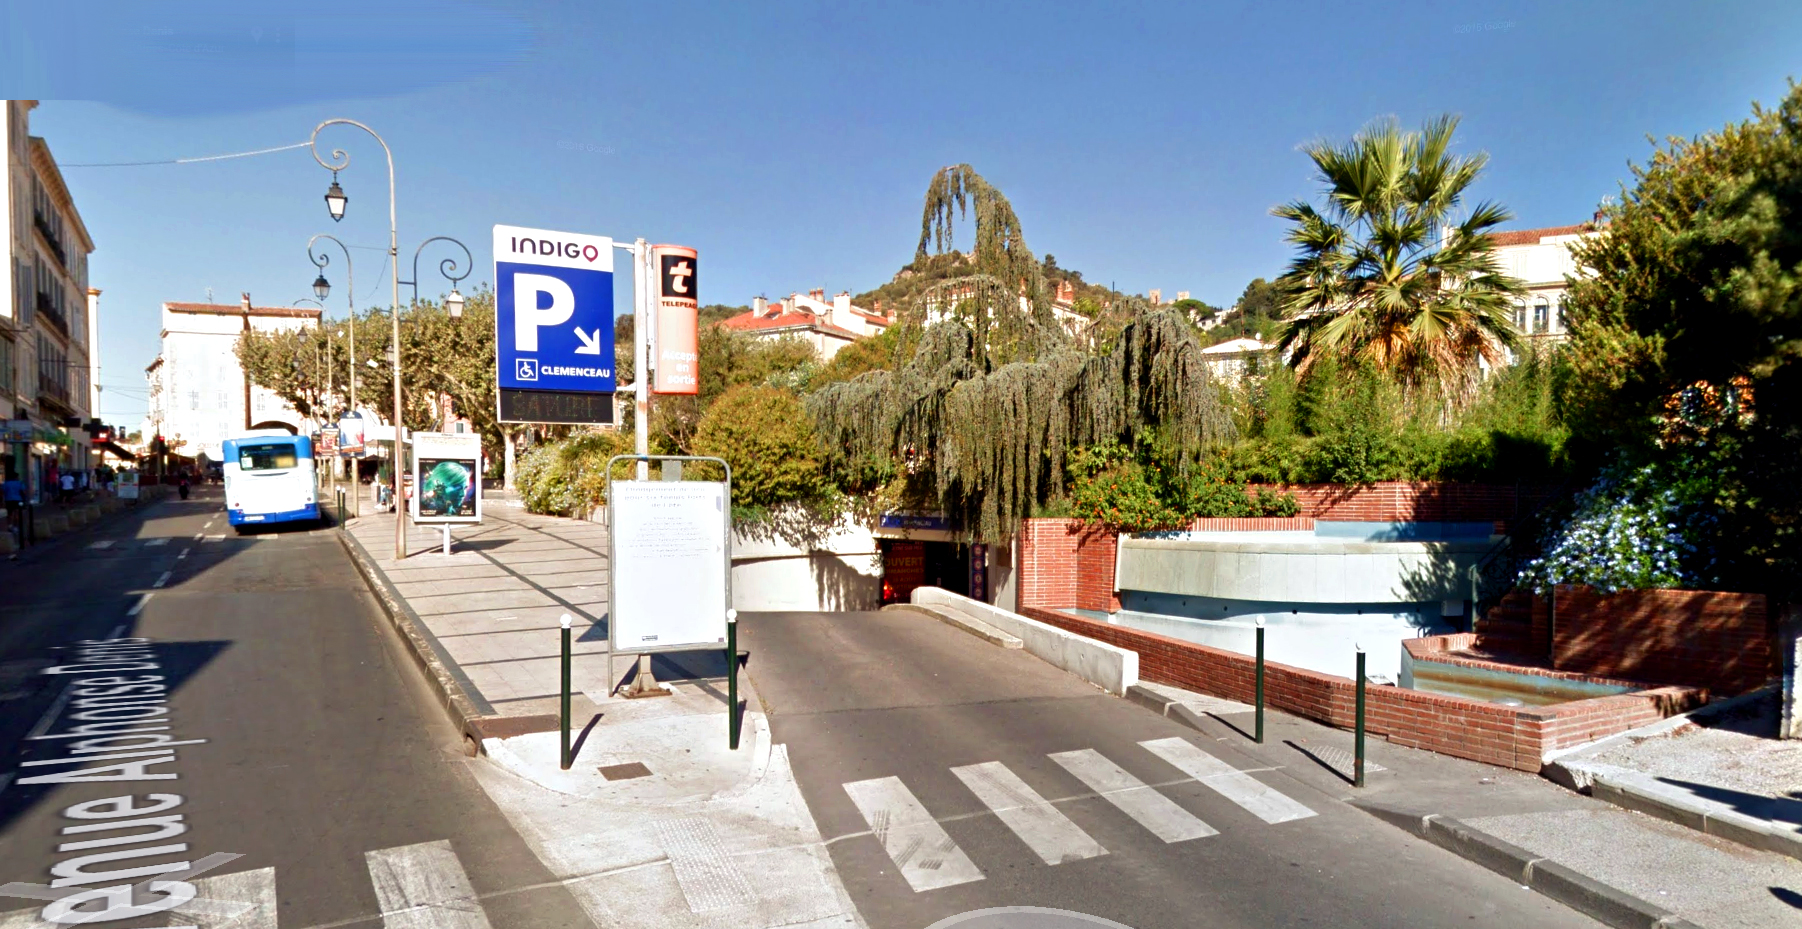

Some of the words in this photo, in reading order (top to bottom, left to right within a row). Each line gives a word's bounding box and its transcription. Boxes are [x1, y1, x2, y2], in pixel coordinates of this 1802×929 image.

[511, 236, 599, 263] INDIGO
[669, 261, 692, 293] t
[513, 272, 575, 352] P
[541, 365, 610, 378] CLEMENCEAU
[676, 364, 689, 372] en
[667, 374, 696, 385] sortie
[885, 556, 923, 567] OUVERT
